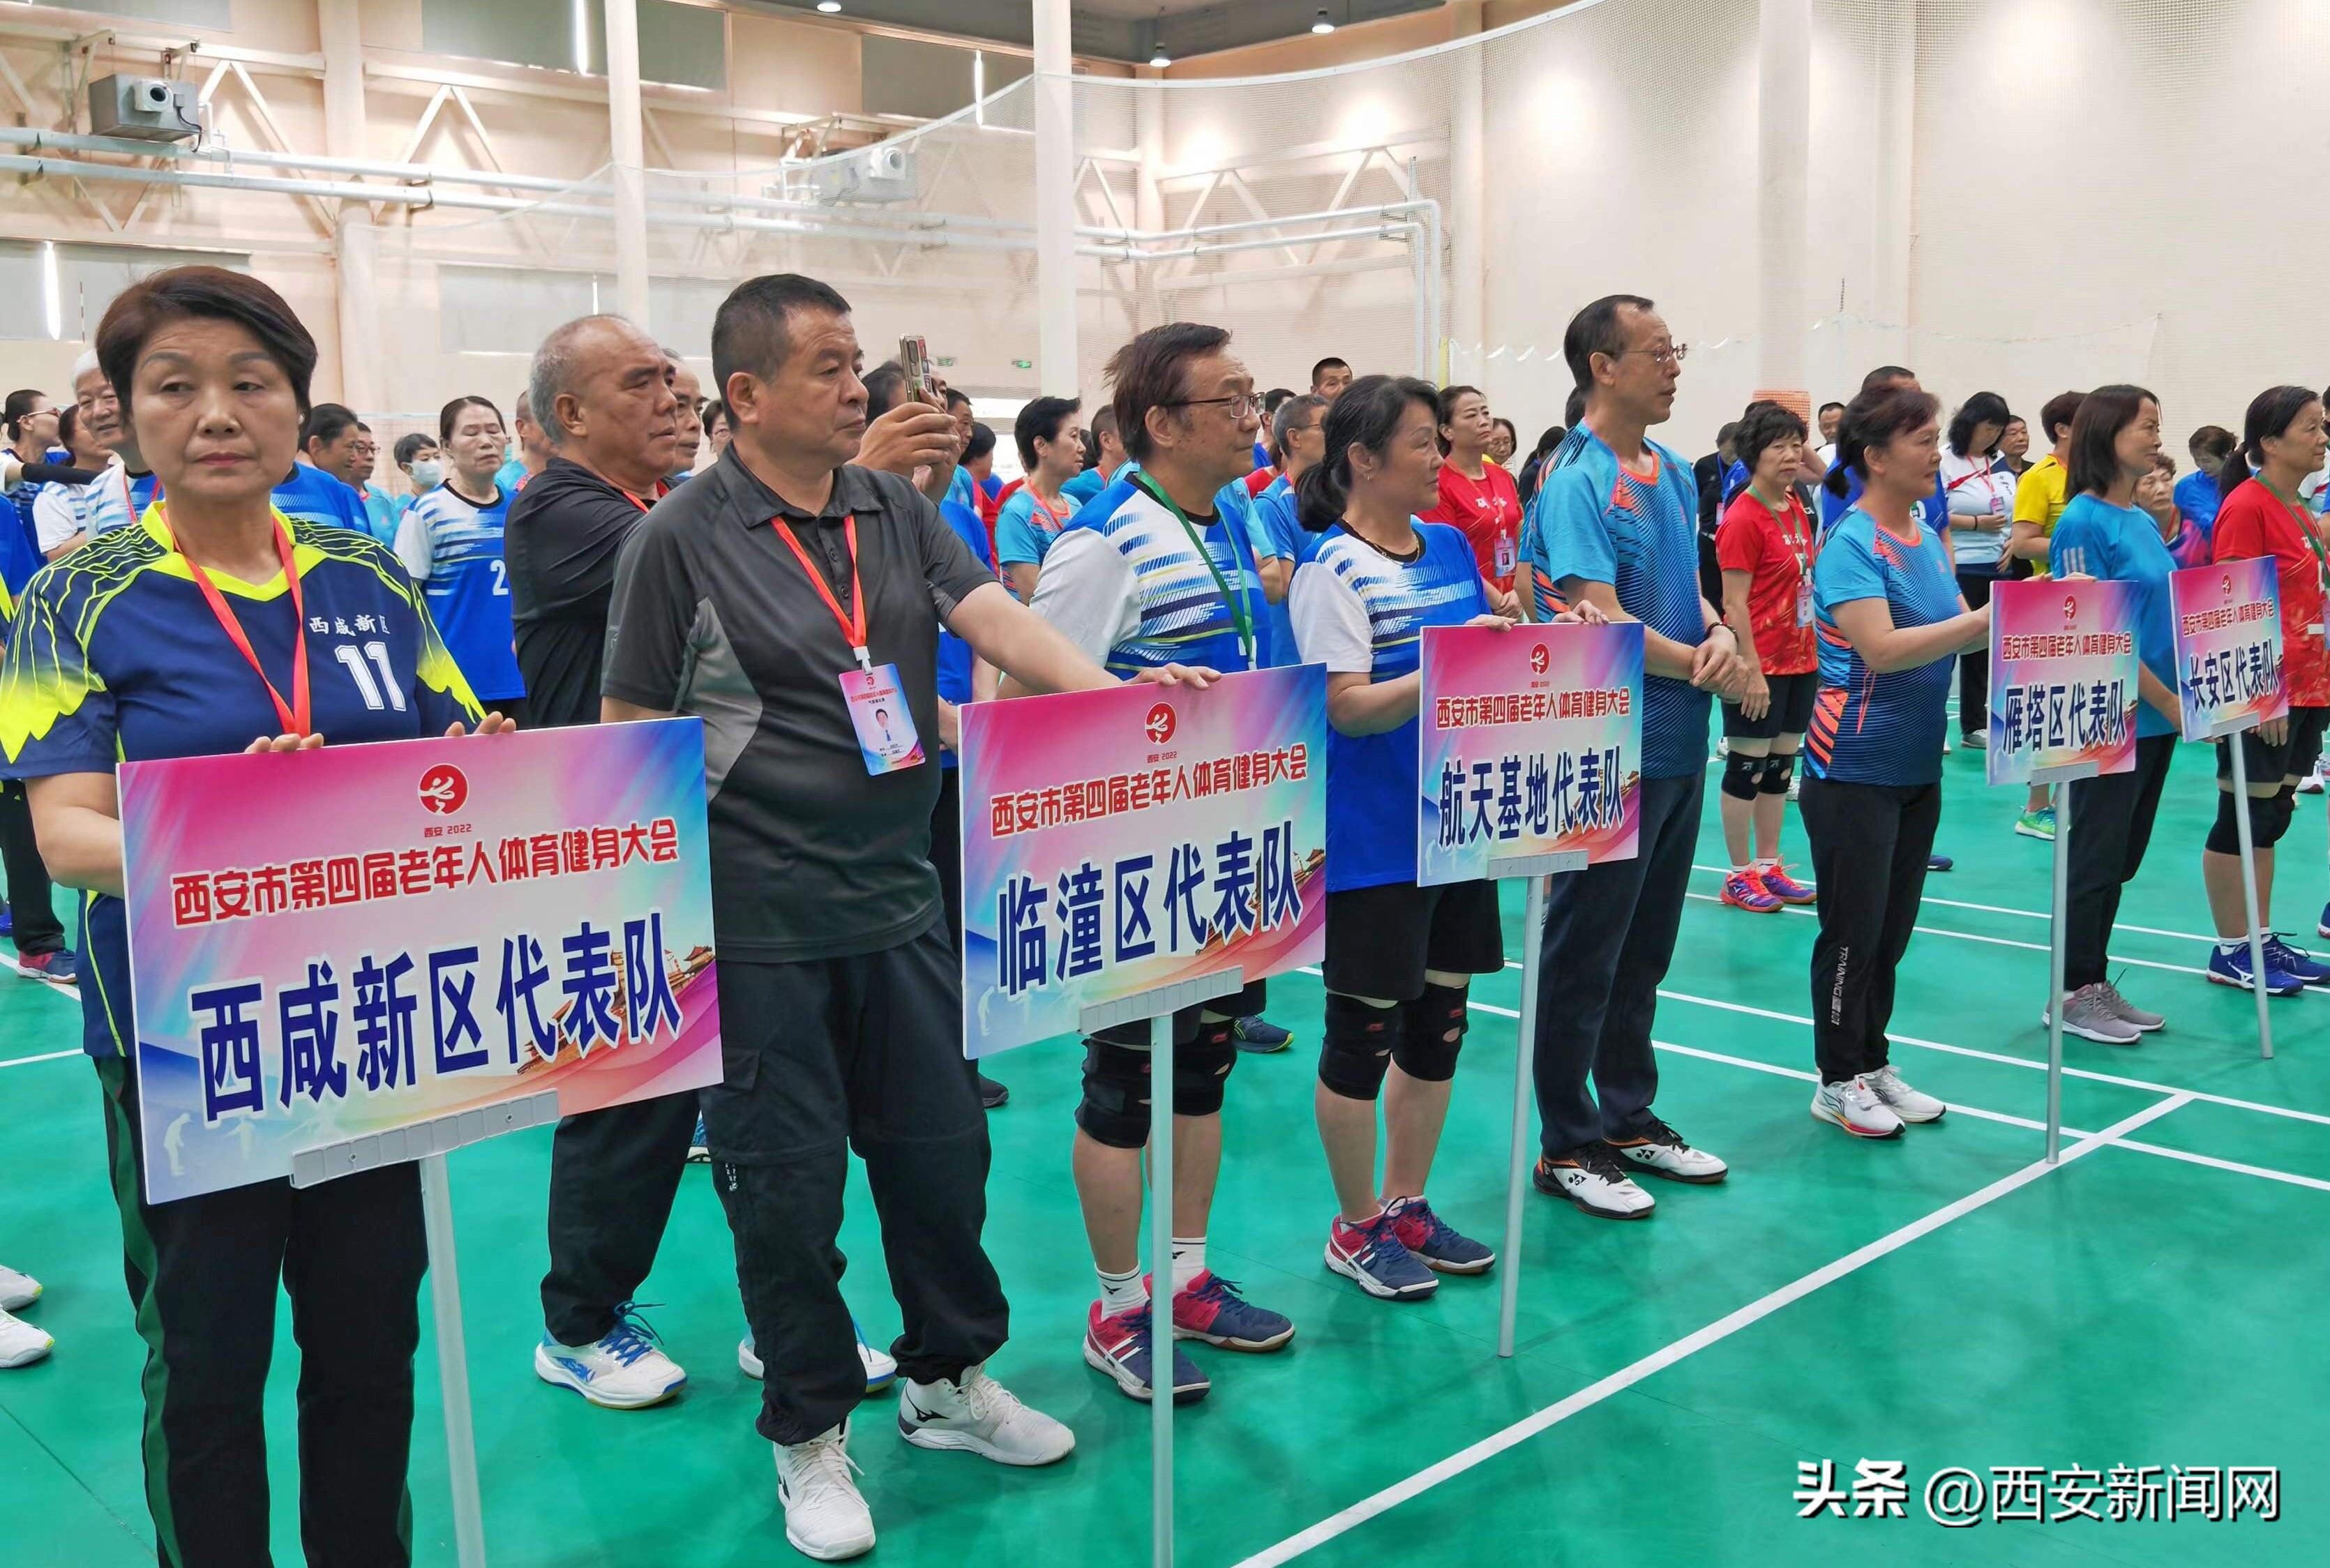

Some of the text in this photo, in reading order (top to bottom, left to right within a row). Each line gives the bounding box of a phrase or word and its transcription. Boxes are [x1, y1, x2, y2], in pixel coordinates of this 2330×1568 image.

[2003, 633, 2132, 661] 西安市第四届老年人体育健身大会
[2182, 598, 2275, 638] 西安市第四届老年人体育健身大会
[335, 641, 406, 711] 11
[1437, 688, 1630, 728] 西安市第四届老年人体育健身大会
[2189, 639, 2280, 711] 长安区代表队
[2002, 679, 2126, 755] 雁塔区代表队
[991, 744, 1307, 837] 西安市第四届老年人体育健身大会
[1162, 751, 1178, 760] 2022
[447, 824, 472, 834] 2022
[1438, 745, 1623, 847] 航天基地代表队
[173, 820, 678, 926] 西安市第四届老年人体育健身大会
[999, 821, 1302, 996] 临潼区代表队
[1833, 946, 1849, 997] TRAINING
[191, 913, 681, 1122] 西咸新区代表队
